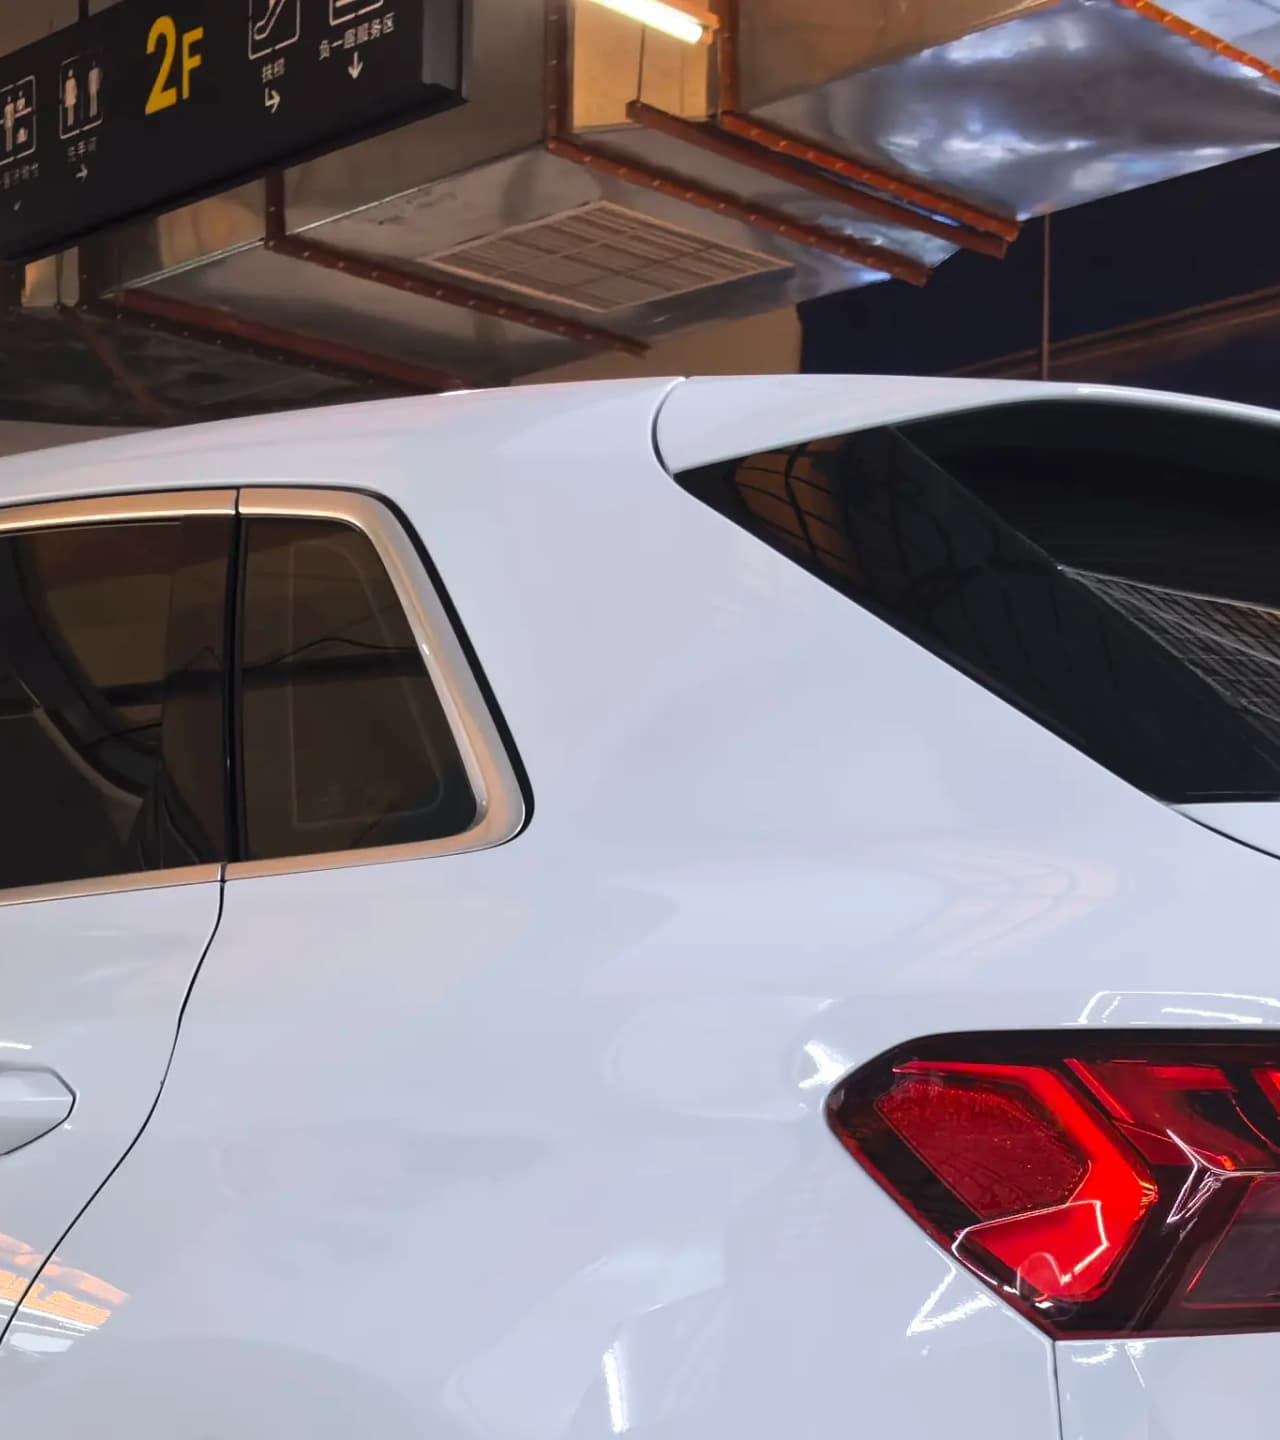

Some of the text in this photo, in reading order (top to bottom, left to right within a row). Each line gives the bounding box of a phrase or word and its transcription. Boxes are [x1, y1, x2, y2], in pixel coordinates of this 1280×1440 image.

[144, 15, 204, 115] 2F
[319, 12, 395, 61] 负一层服务区
